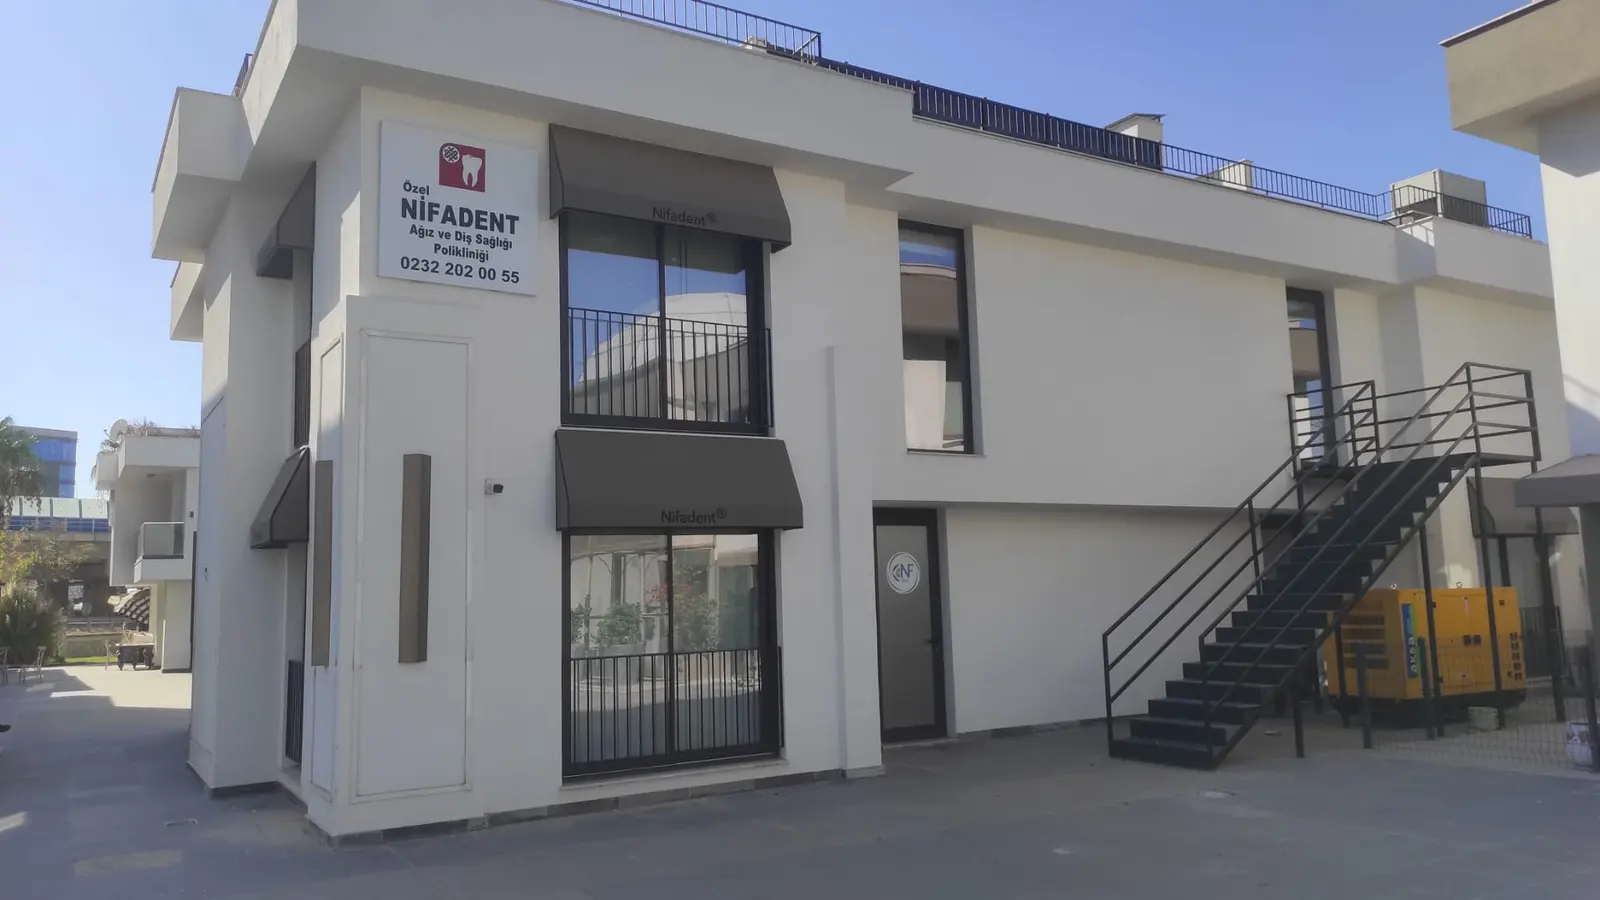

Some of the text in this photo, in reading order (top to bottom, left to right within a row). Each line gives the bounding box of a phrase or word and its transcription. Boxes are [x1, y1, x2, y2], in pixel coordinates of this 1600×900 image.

[403, 180, 430, 195] Özel
[401, 196, 520, 235] NİFADENT
[409, 224, 513, 251] Ağız ve Diş Sağlığı
[433, 243, 489, 263] Polikliniği
[400, 256, 520, 284] 0232 202 00 55
